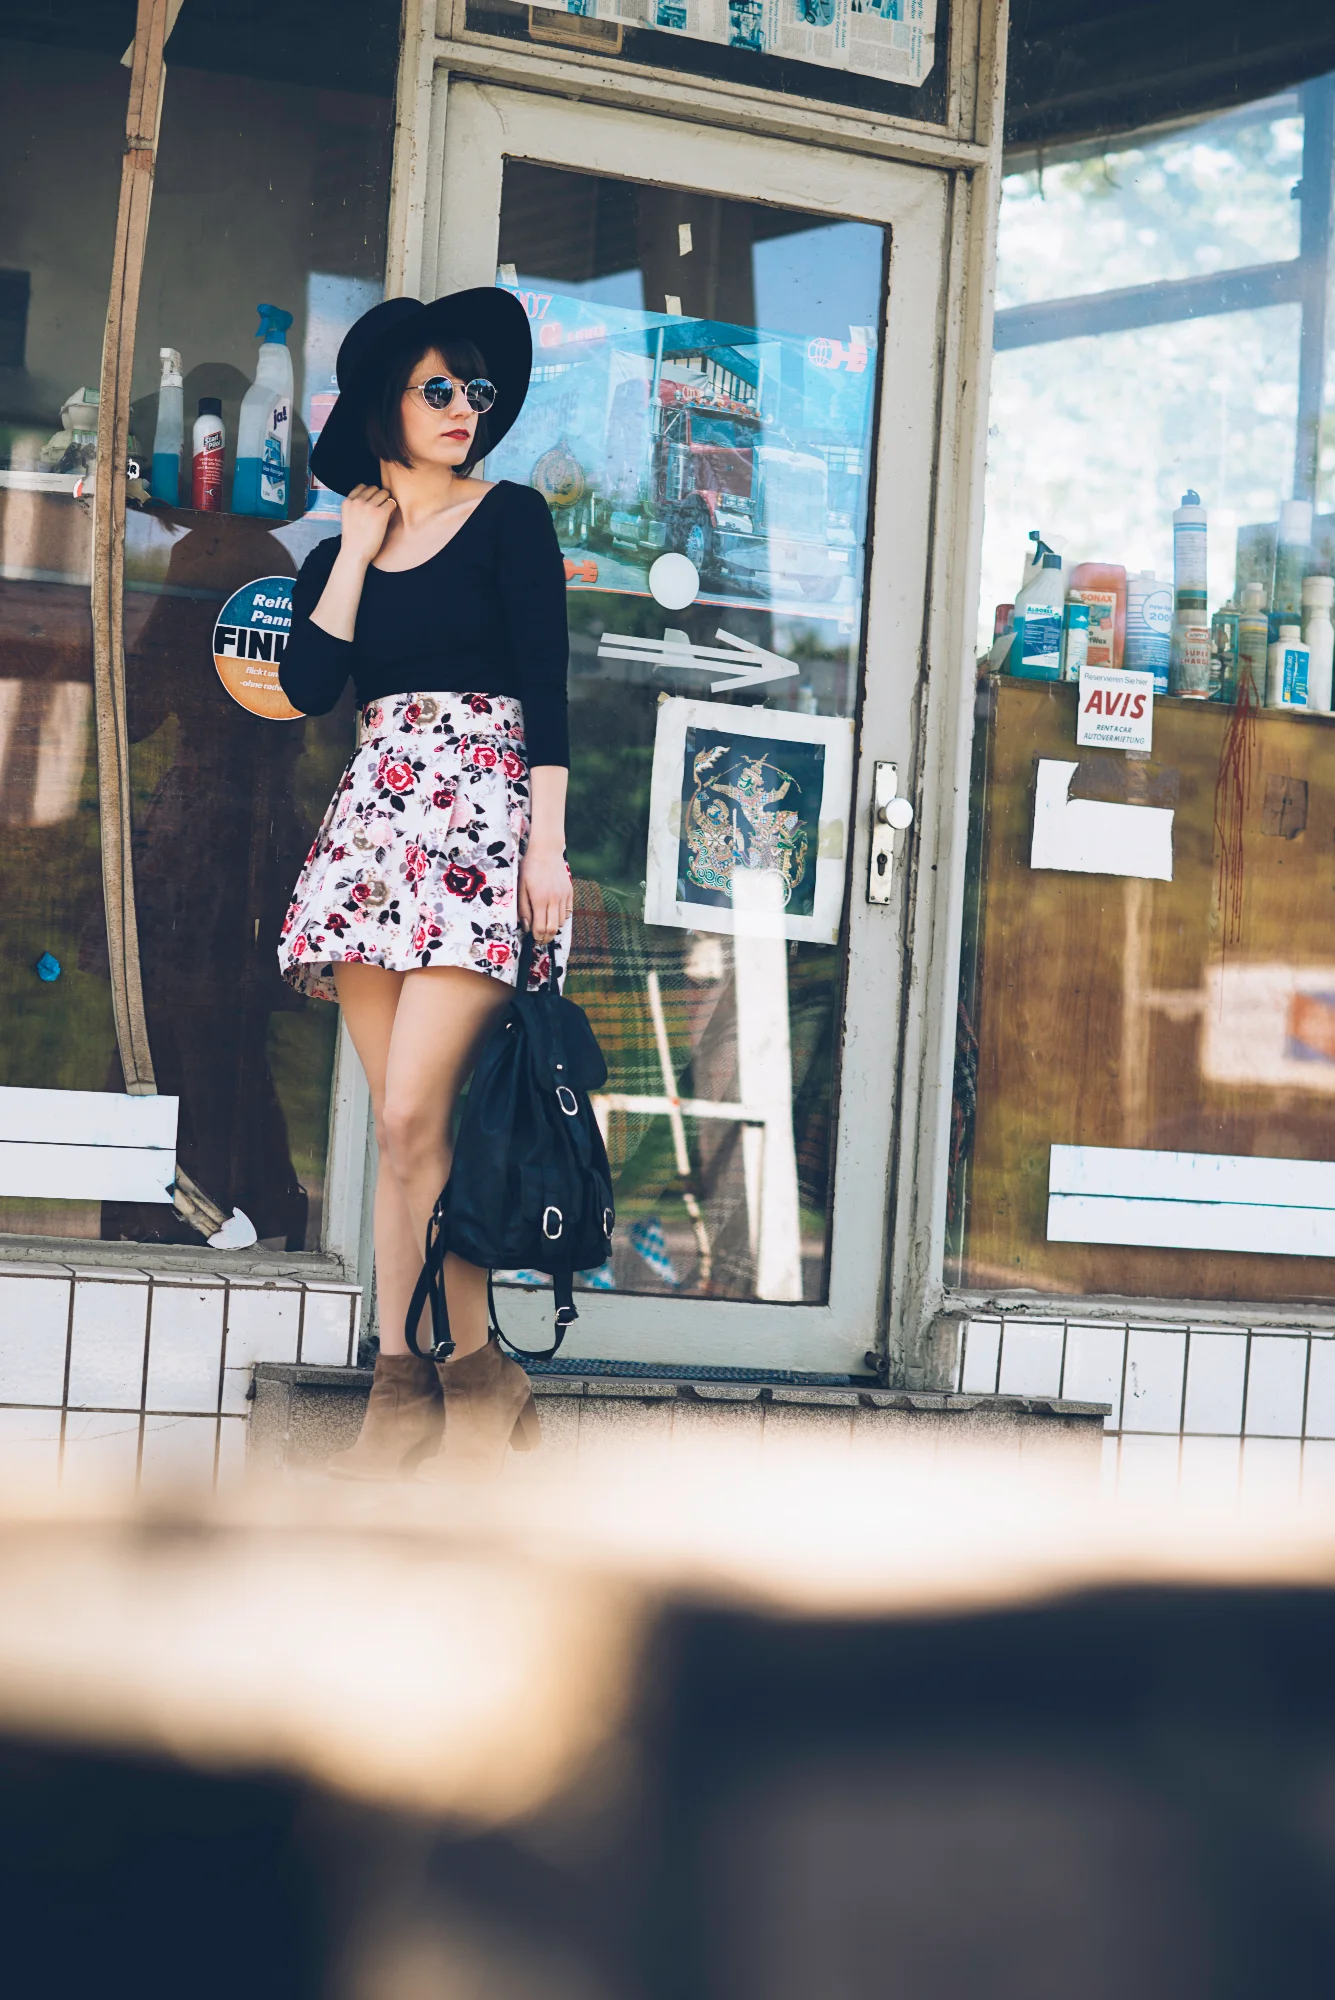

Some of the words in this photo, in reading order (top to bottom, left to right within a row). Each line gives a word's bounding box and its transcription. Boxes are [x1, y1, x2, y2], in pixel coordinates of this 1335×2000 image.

[273, 406, 288, 431] ja!
[1081, 593, 1112, 602] SONAX
[1084, 672, 1124, 684] Reservieren
[1125, 677, 1135, 685] Sie
[1136, 678, 1148, 686] hier
[1084, 690, 1147, 719] AVIS
[1096, 724, 1113, 732] RENT
[1083, 733, 1145, 745] AUTOVERMIETUNG
